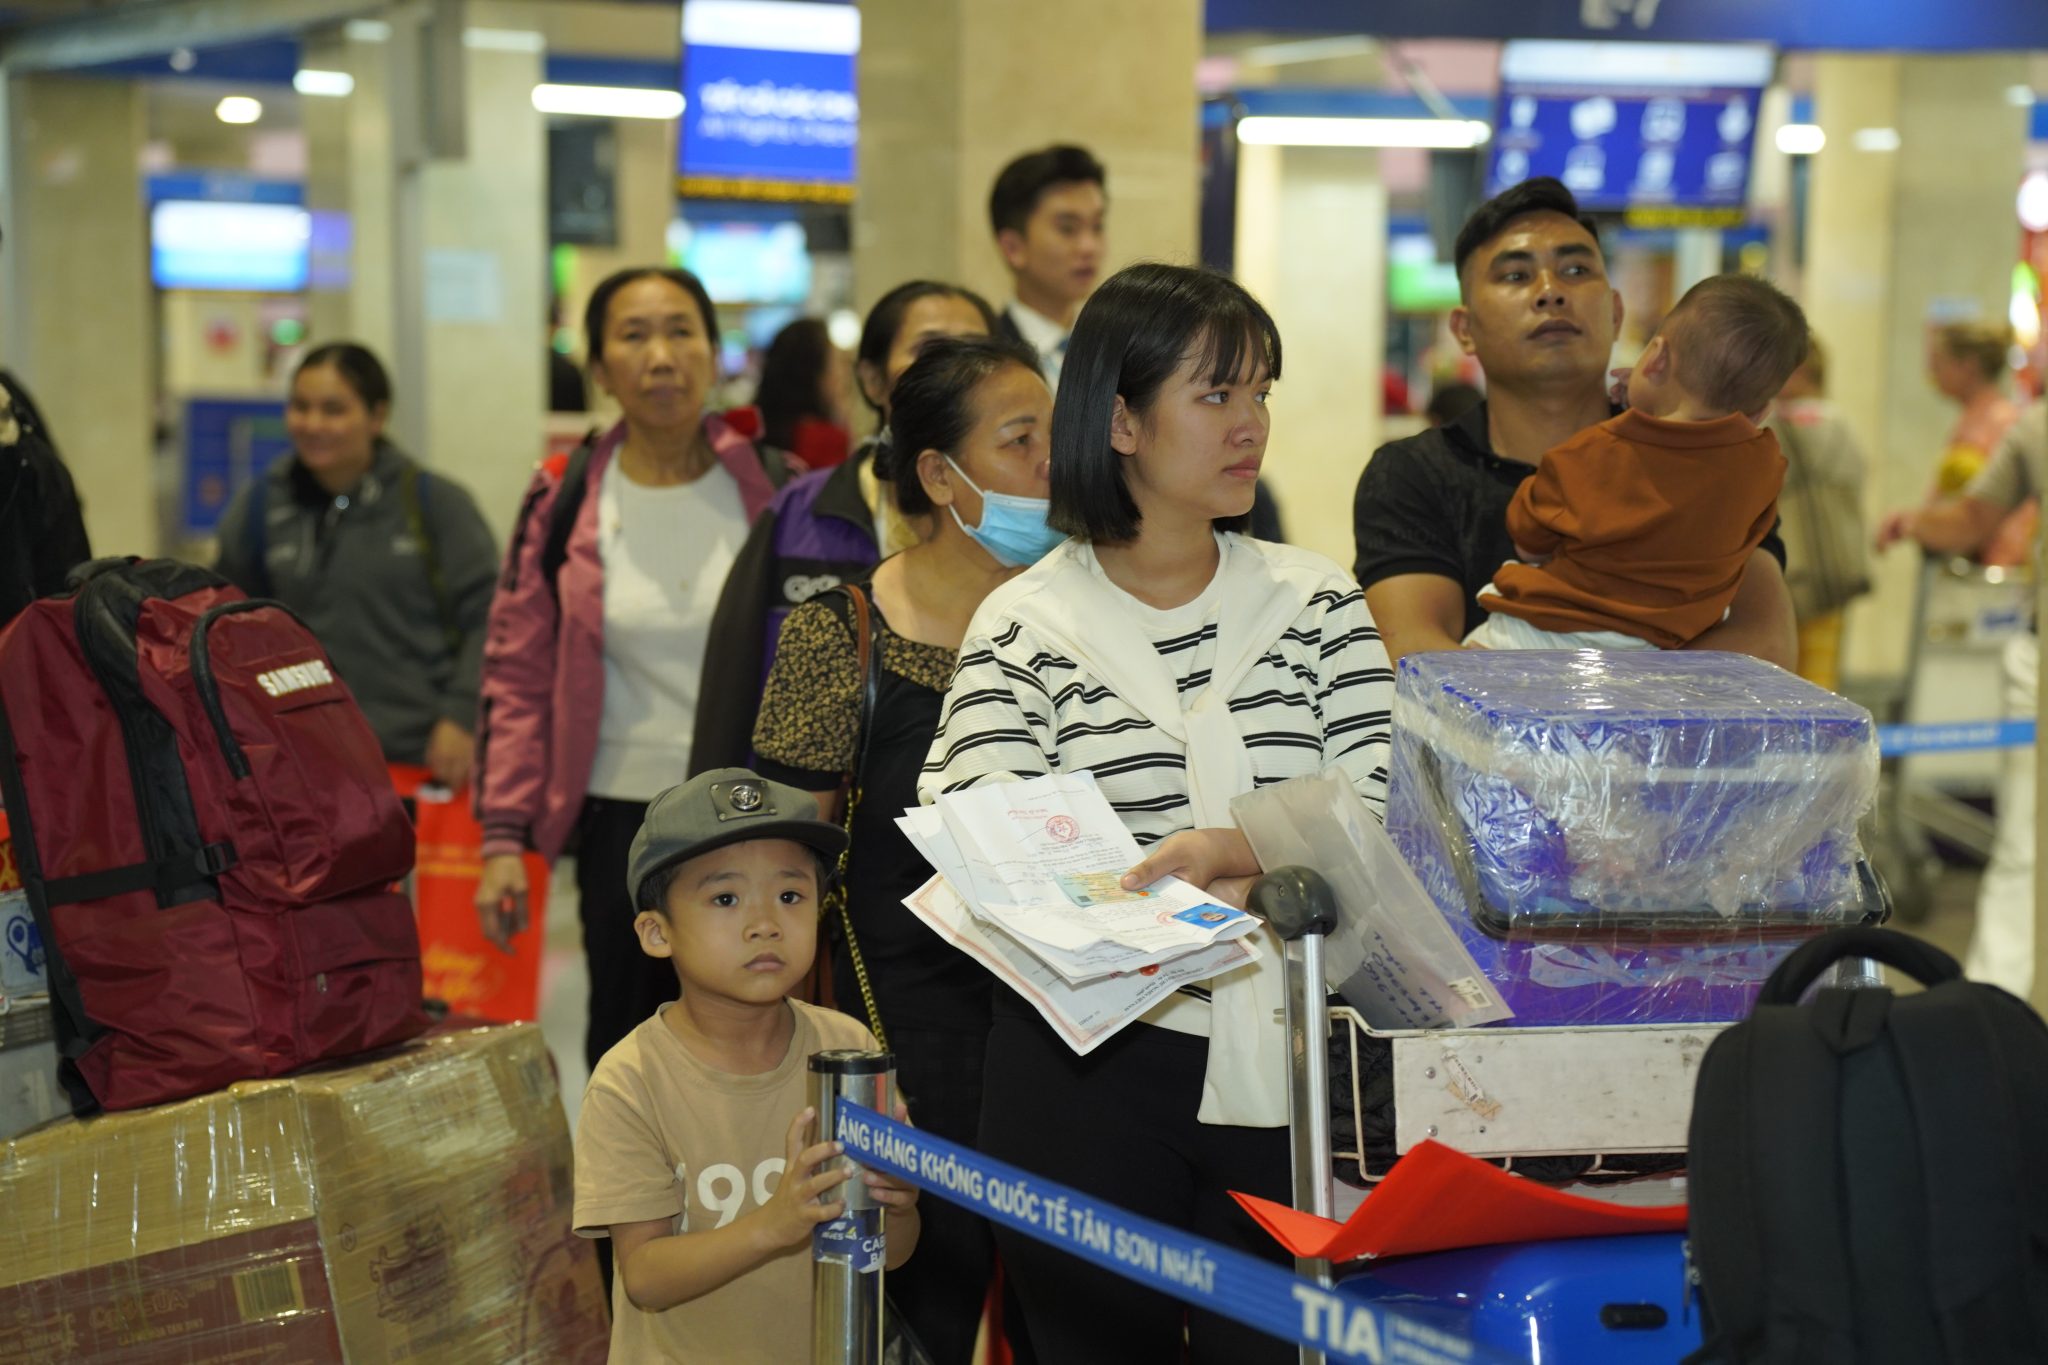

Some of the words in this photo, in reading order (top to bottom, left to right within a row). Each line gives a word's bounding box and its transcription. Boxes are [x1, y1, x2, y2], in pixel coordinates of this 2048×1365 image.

[257, 659, 334, 698] SAMSUNG
[920, 1151, 983, 1201] KHÔNG
[986, 1180, 1040, 1225] QUỐC
[1043, 1197, 1069, 1237] TẾ
[1070, 1208, 1111, 1254] TÂN
[1114, 1227, 1158, 1273] SƠN
[1161, 1247, 1217, 1295] NHẤT
[1292, 1283, 1383, 1365] TIA
